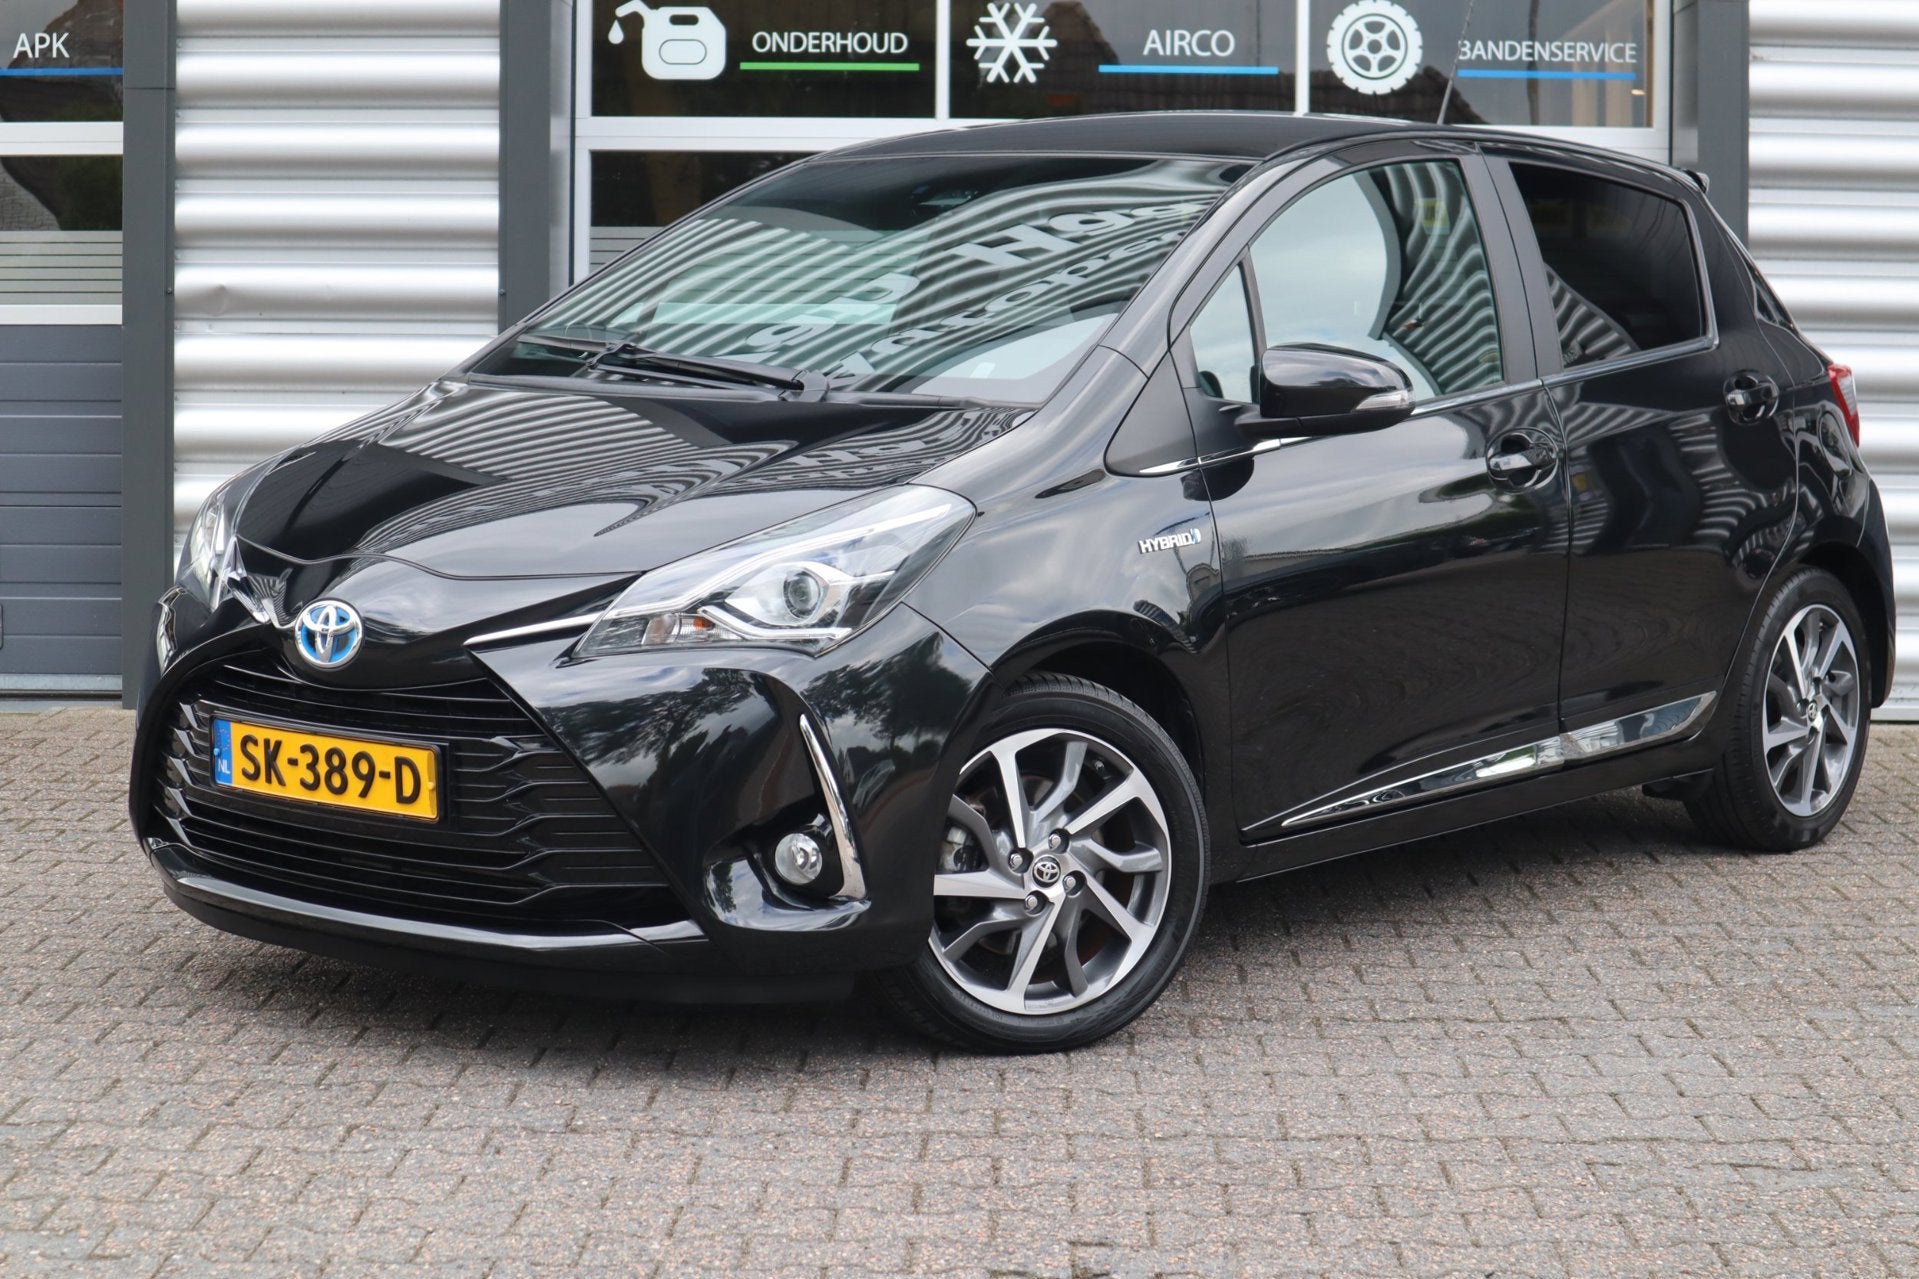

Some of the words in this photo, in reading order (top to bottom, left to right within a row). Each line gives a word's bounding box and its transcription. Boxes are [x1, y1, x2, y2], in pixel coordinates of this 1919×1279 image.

[13, 32, 70, 58] APK
[752, 31, 908, 53] ONDERHOUD
[1143, 30, 1235, 56] AIRCO
[1457, 39, 1637, 63] BANDENSERVICE
[1138, 532, 1195, 553] HYBRID
[217, 758, 231, 774] NL
[240, 734, 421, 805] SK-389-D
